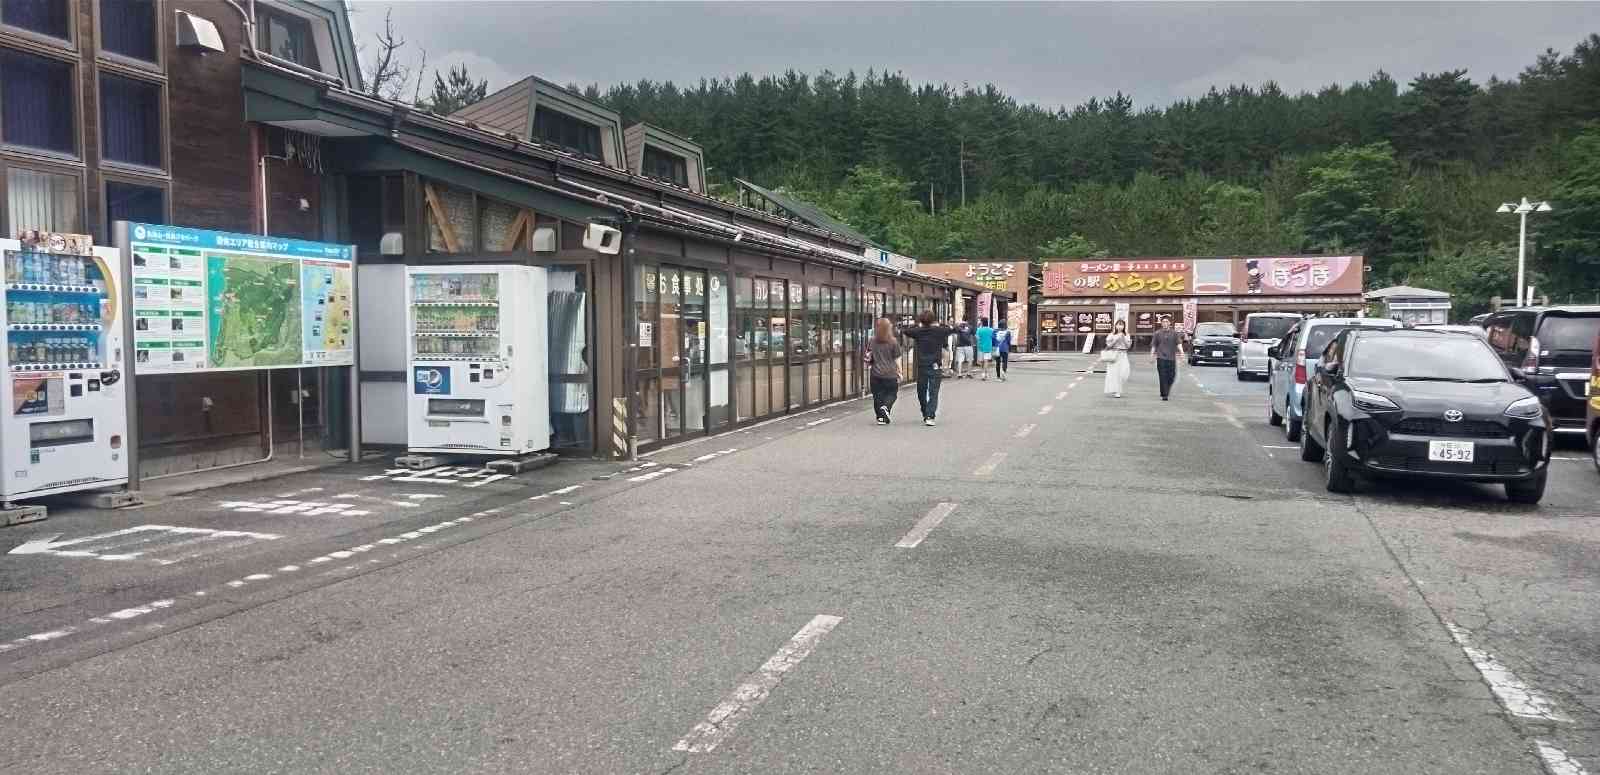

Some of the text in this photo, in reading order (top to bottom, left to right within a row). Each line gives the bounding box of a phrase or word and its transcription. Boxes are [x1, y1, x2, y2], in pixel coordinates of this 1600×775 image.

[966, 264, 1016, 278] ようこそ
[660, 272, 704, 297] お食事処
[1103, 272, 1184, 292] ふらっと
[1439, 448, 1472, 461] 45-92
